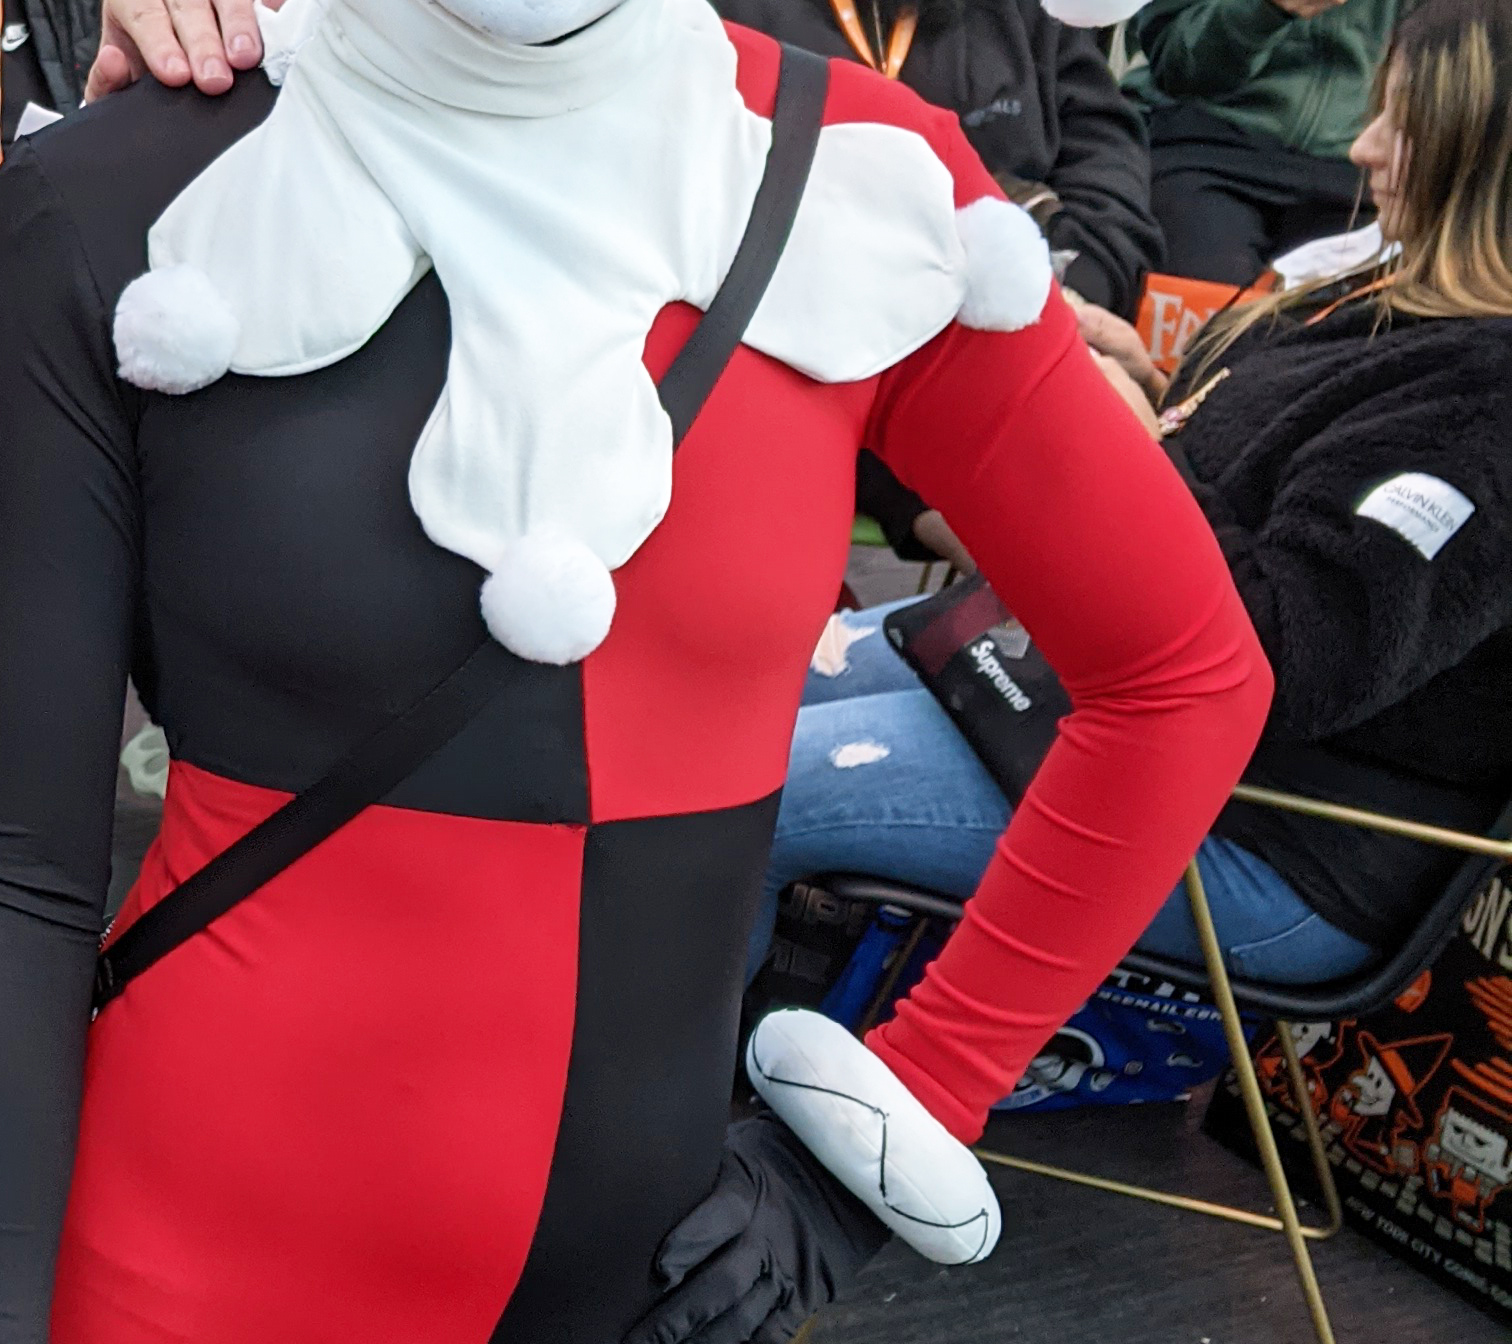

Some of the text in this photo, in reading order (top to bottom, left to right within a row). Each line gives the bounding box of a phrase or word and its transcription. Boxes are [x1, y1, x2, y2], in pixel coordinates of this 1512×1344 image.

[1384, 483, 1457, 532] CALVIN KLEIN
[971, 640, 1031, 711] Supreme
